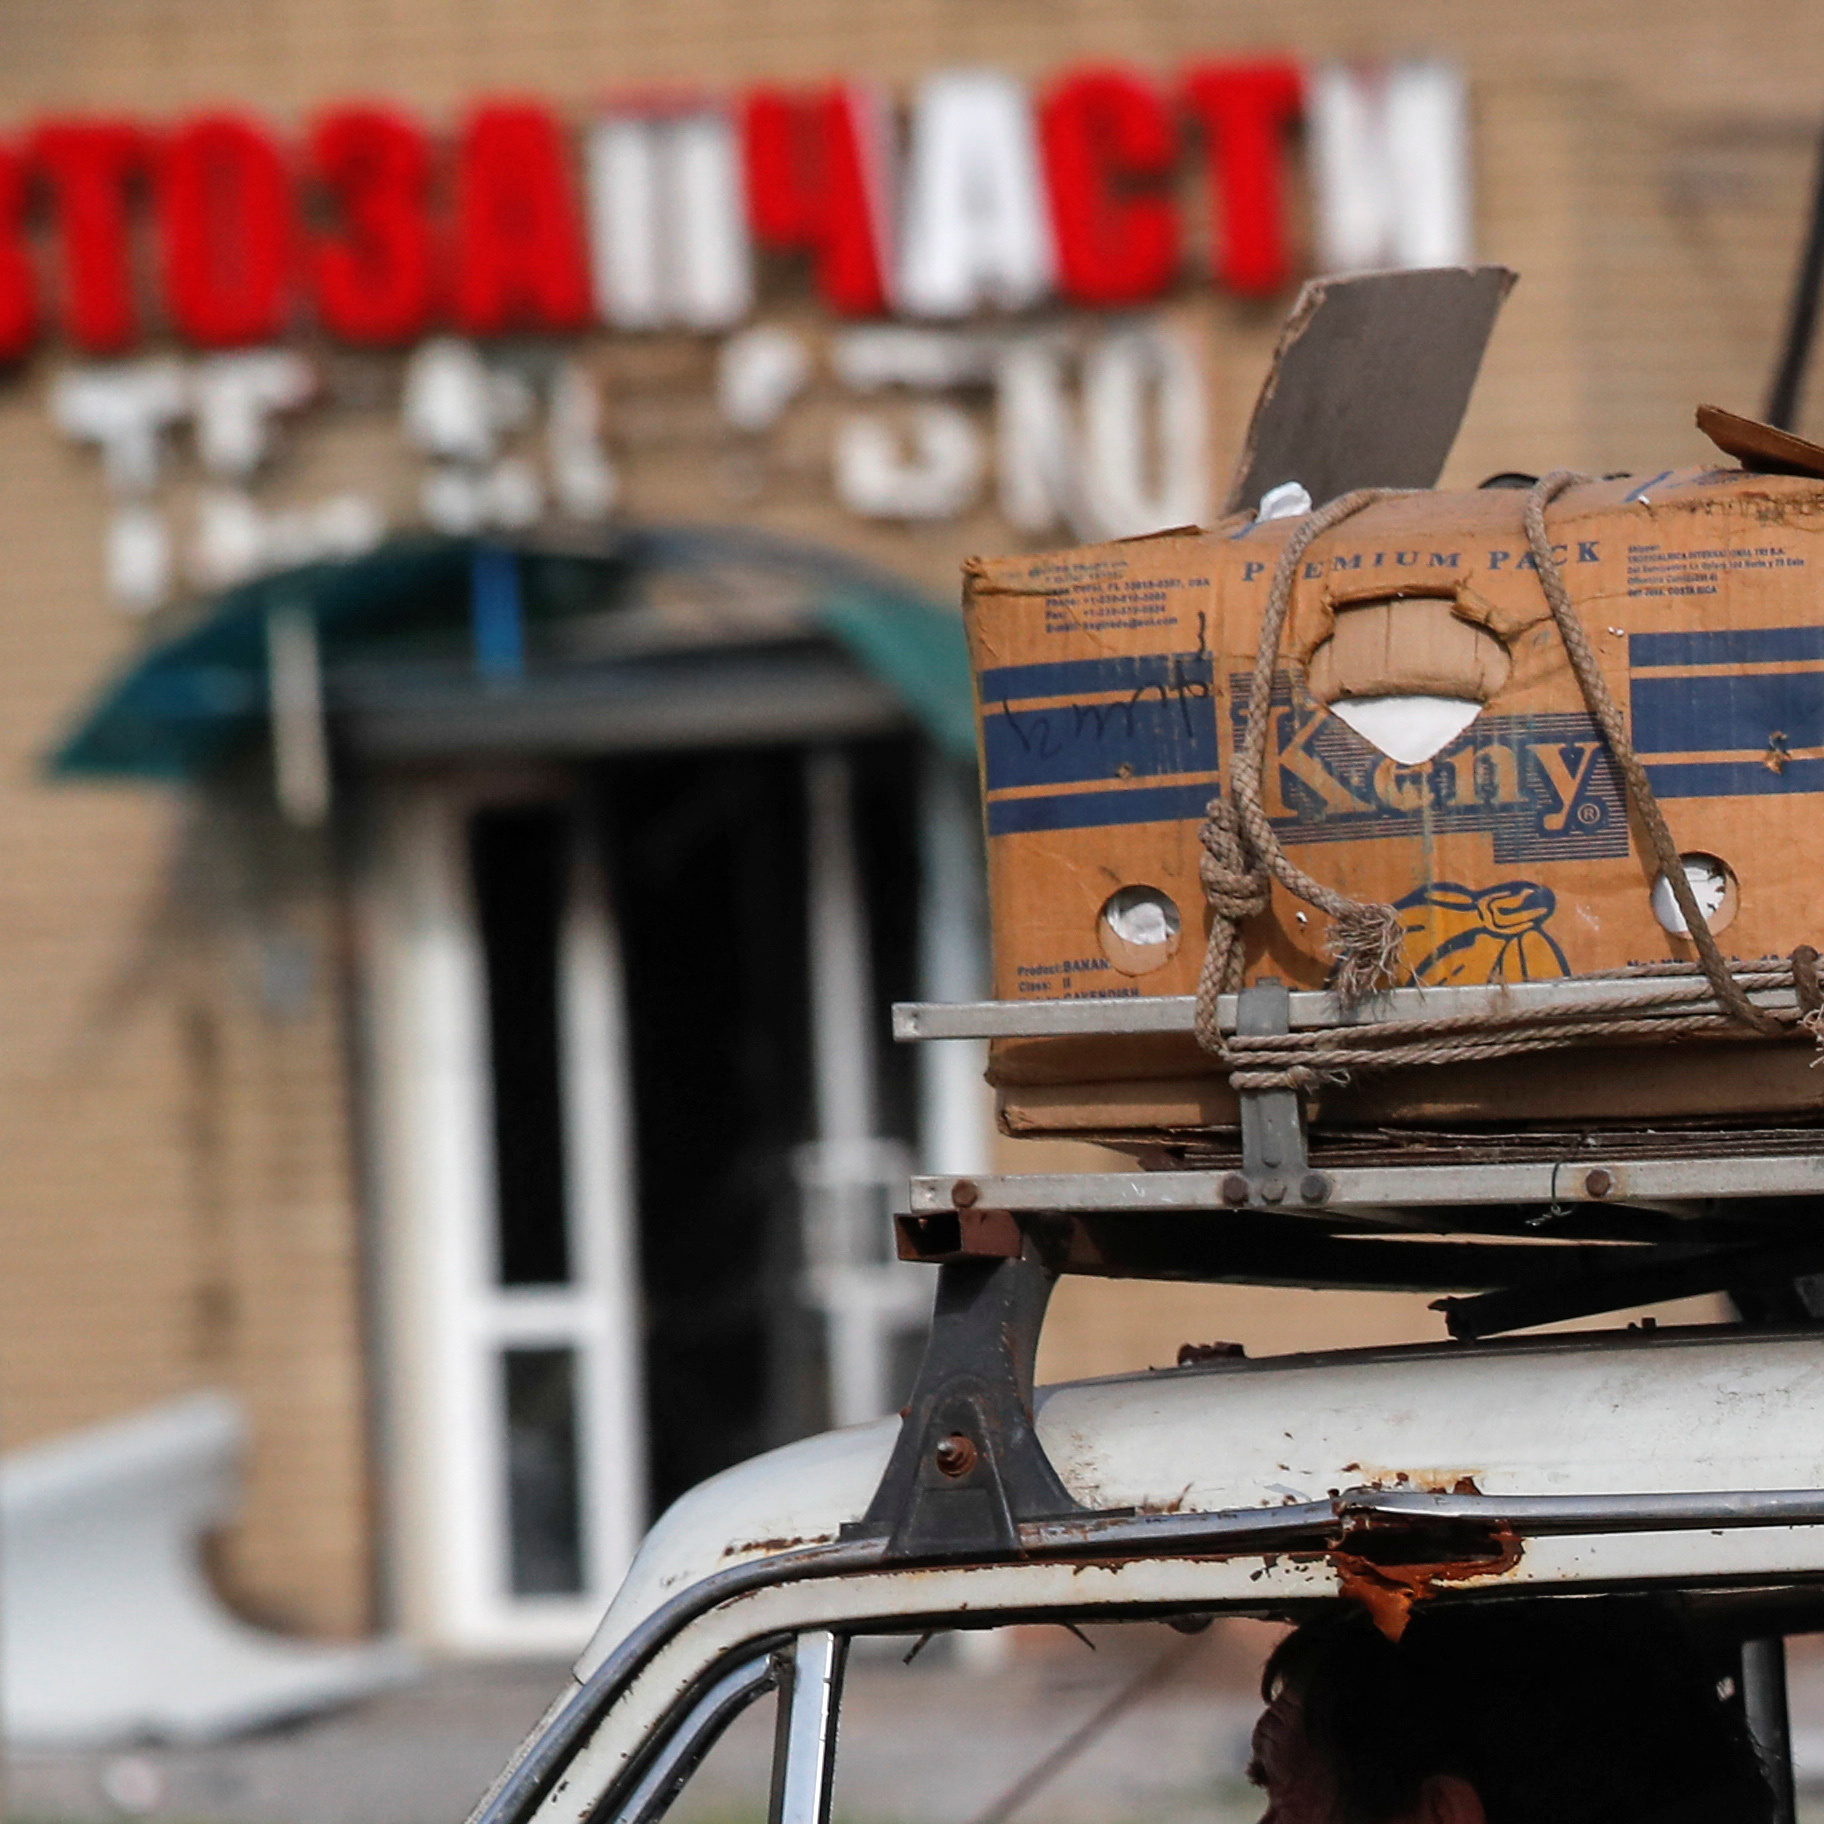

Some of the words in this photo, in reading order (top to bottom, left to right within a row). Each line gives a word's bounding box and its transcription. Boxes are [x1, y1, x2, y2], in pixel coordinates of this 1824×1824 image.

[1241, 549, 1462, 582] PEMIUM
[1488, 541, 1601, 570] PACK
[1238, 702, 1602, 832] Keny
[1063, 959, 1112, 973] BANAN
